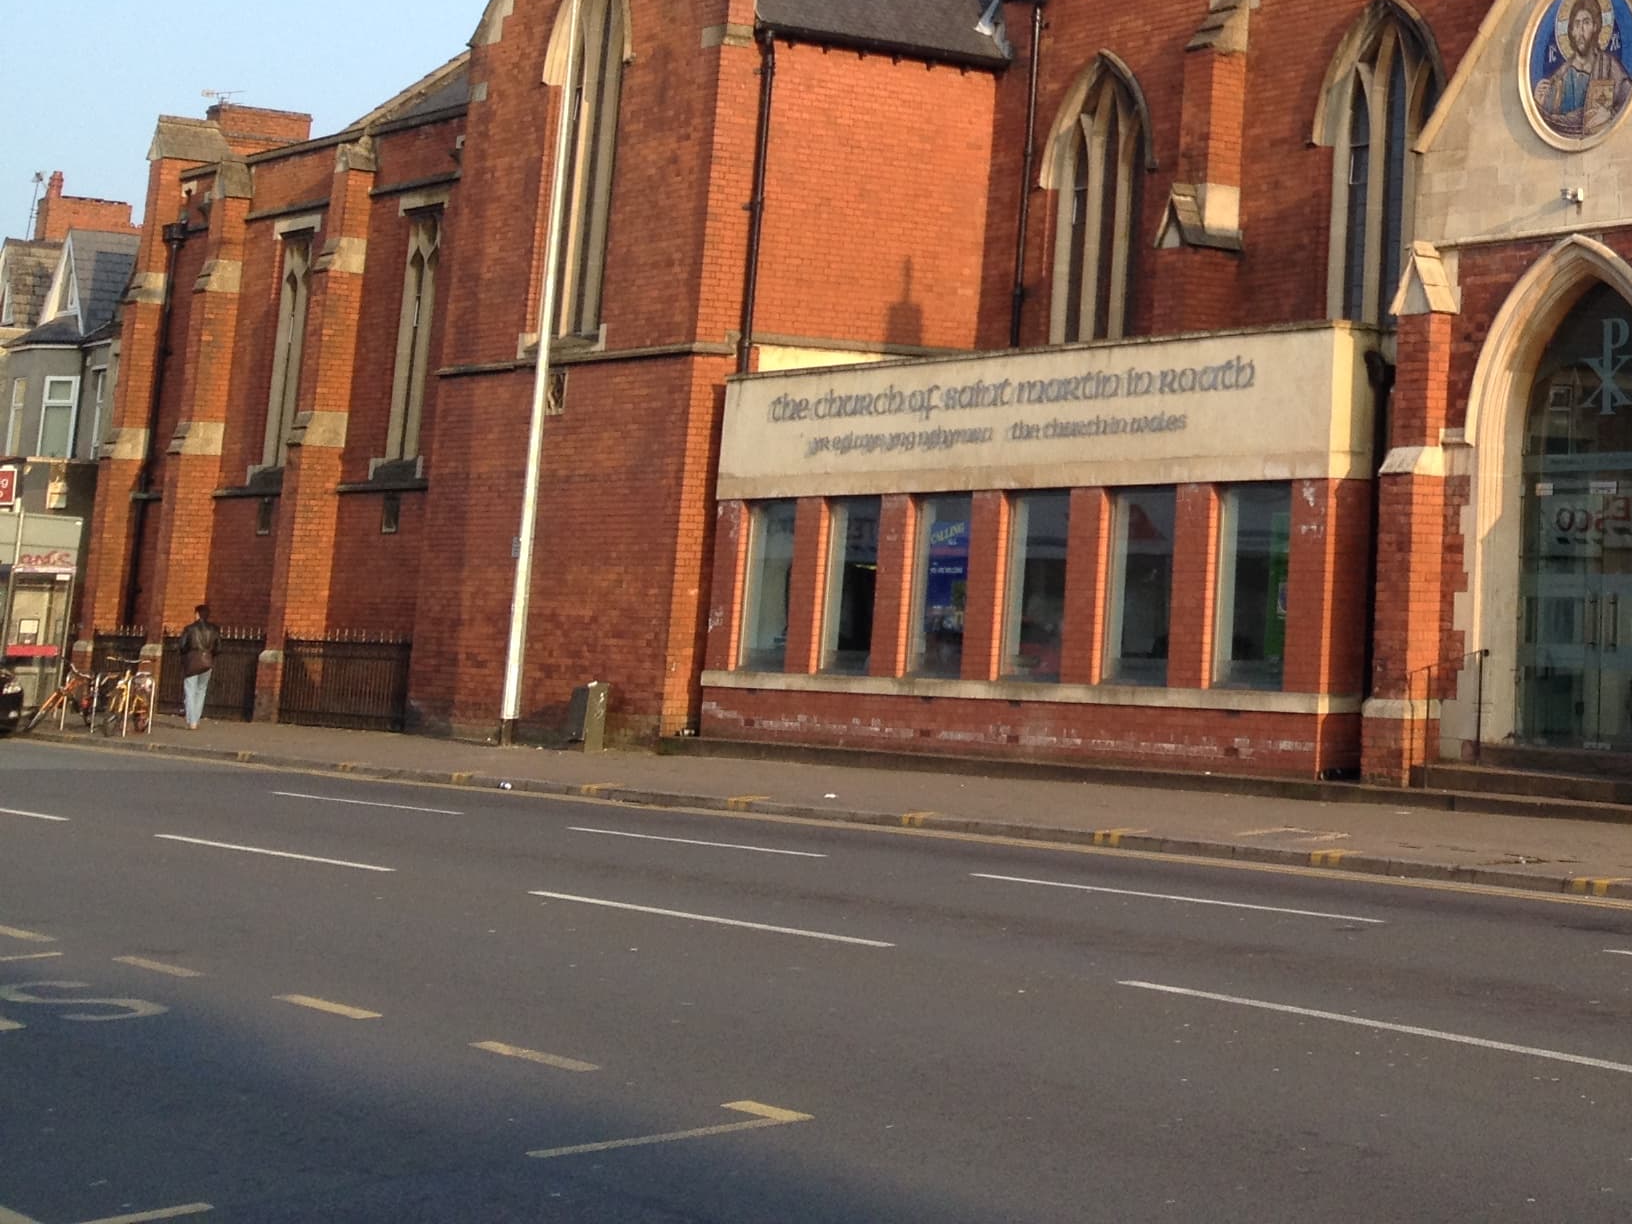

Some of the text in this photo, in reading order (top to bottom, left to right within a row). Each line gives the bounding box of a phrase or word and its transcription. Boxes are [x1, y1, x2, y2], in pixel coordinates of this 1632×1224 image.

[769, 393, 809, 423] the
[814, 384, 904, 421] church
[908, 384, 941, 421] of
[945, 378, 1009, 410] saint
[1016, 369, 1120, 405] martin
[1126, 367, 1152, 398] in
